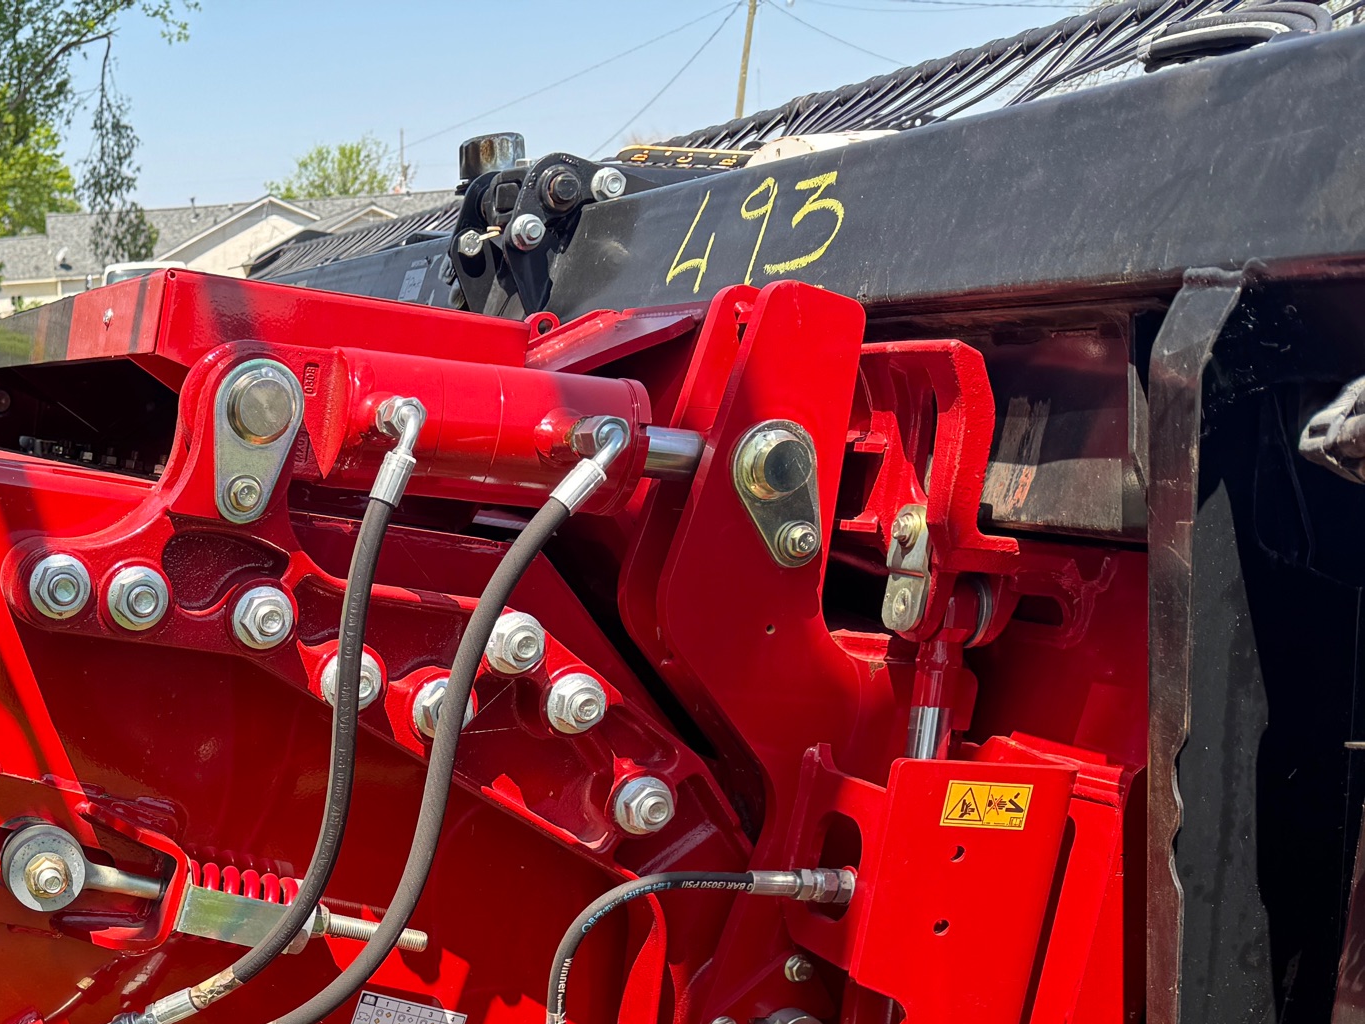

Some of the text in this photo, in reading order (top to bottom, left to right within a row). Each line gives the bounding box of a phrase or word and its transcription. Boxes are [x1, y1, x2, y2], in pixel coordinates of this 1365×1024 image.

[665, 170, 845, 295] 493
[339, 705, 351, 734] MAX
[681, 880, 700, 889] PSI)
[700, 880, 726, 889] (3050
[726, 881, 746, 890] BAR
[557, 957, 573, 994] Winner
